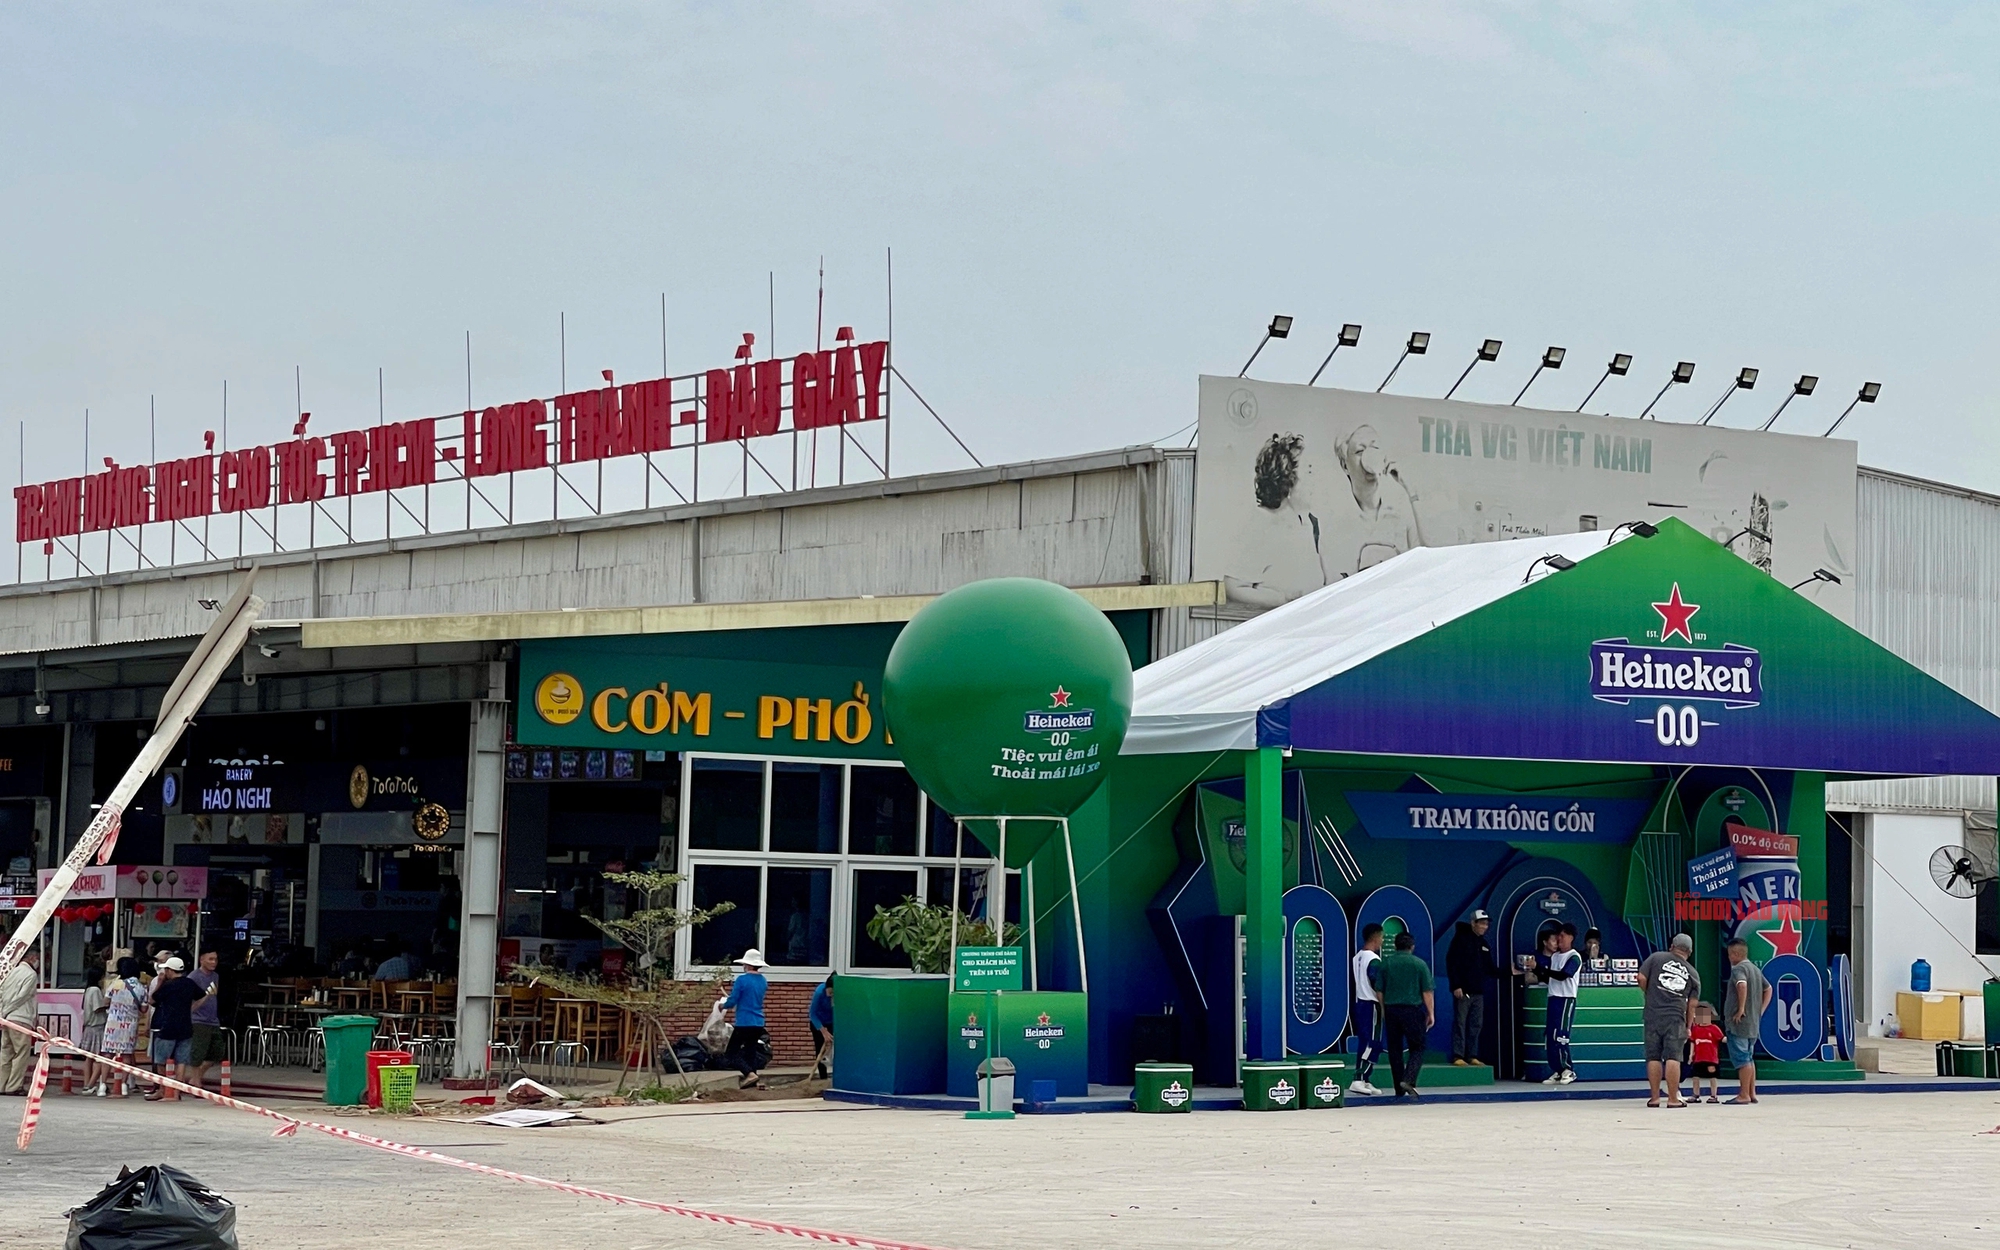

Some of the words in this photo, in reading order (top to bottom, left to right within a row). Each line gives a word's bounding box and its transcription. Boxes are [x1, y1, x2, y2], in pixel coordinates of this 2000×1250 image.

[14, 477, 81, 555] TRẠM
[84, 457, 150, 531] DỪNG
[154, 430, 215, 523] NGHỈ
[218, 445, 271, 513] CAO
[275, 412, 327, 504] TỐC
[463, 399, 548, 478] LONG
[554, 369, 671, 464] THÀNH
[793, 326, 889, 431] GIÂY
[1481, 422, 1517, 461] VG
[1593, 433, 1652, 474] NAM
[592, 682, 711, 736] CƠM
[758, 681, 872, 744] PHỞ
[1657, 704, 1699, 747] 0.0
[1051, 732, 1070, 746] 0.0
[1001, 747, 1034, 765] Tiệc
[1038, 749, 1062, 762] vui
[1065, 748, 1085, 760] êm
[1087, 743, 1099, 757] ái
[226, 768, 253, 781] BAKERY
[991, 765, 1036, 779] Thoải
[1038, 767, 1066, 779] mái
[1068, 763, 1086, 777] lái
[1086, 761, 1100, 773] xe
[202, 781, 232, 809] HẢO
[236, 787, 272, 809] NGHI
[1409, 807, 1472, 836] TRẠM
[1476, 803, 1549, 831] KHÔNG
[1554, 802, 1595, 832] CỒN
[1732, 833, 1757, 846] 0.0%
[1692, 868, 1718, 885] Thoải
[1718, 860, 1735, 875] mái
[1706, 880, 1718, 893] lái
